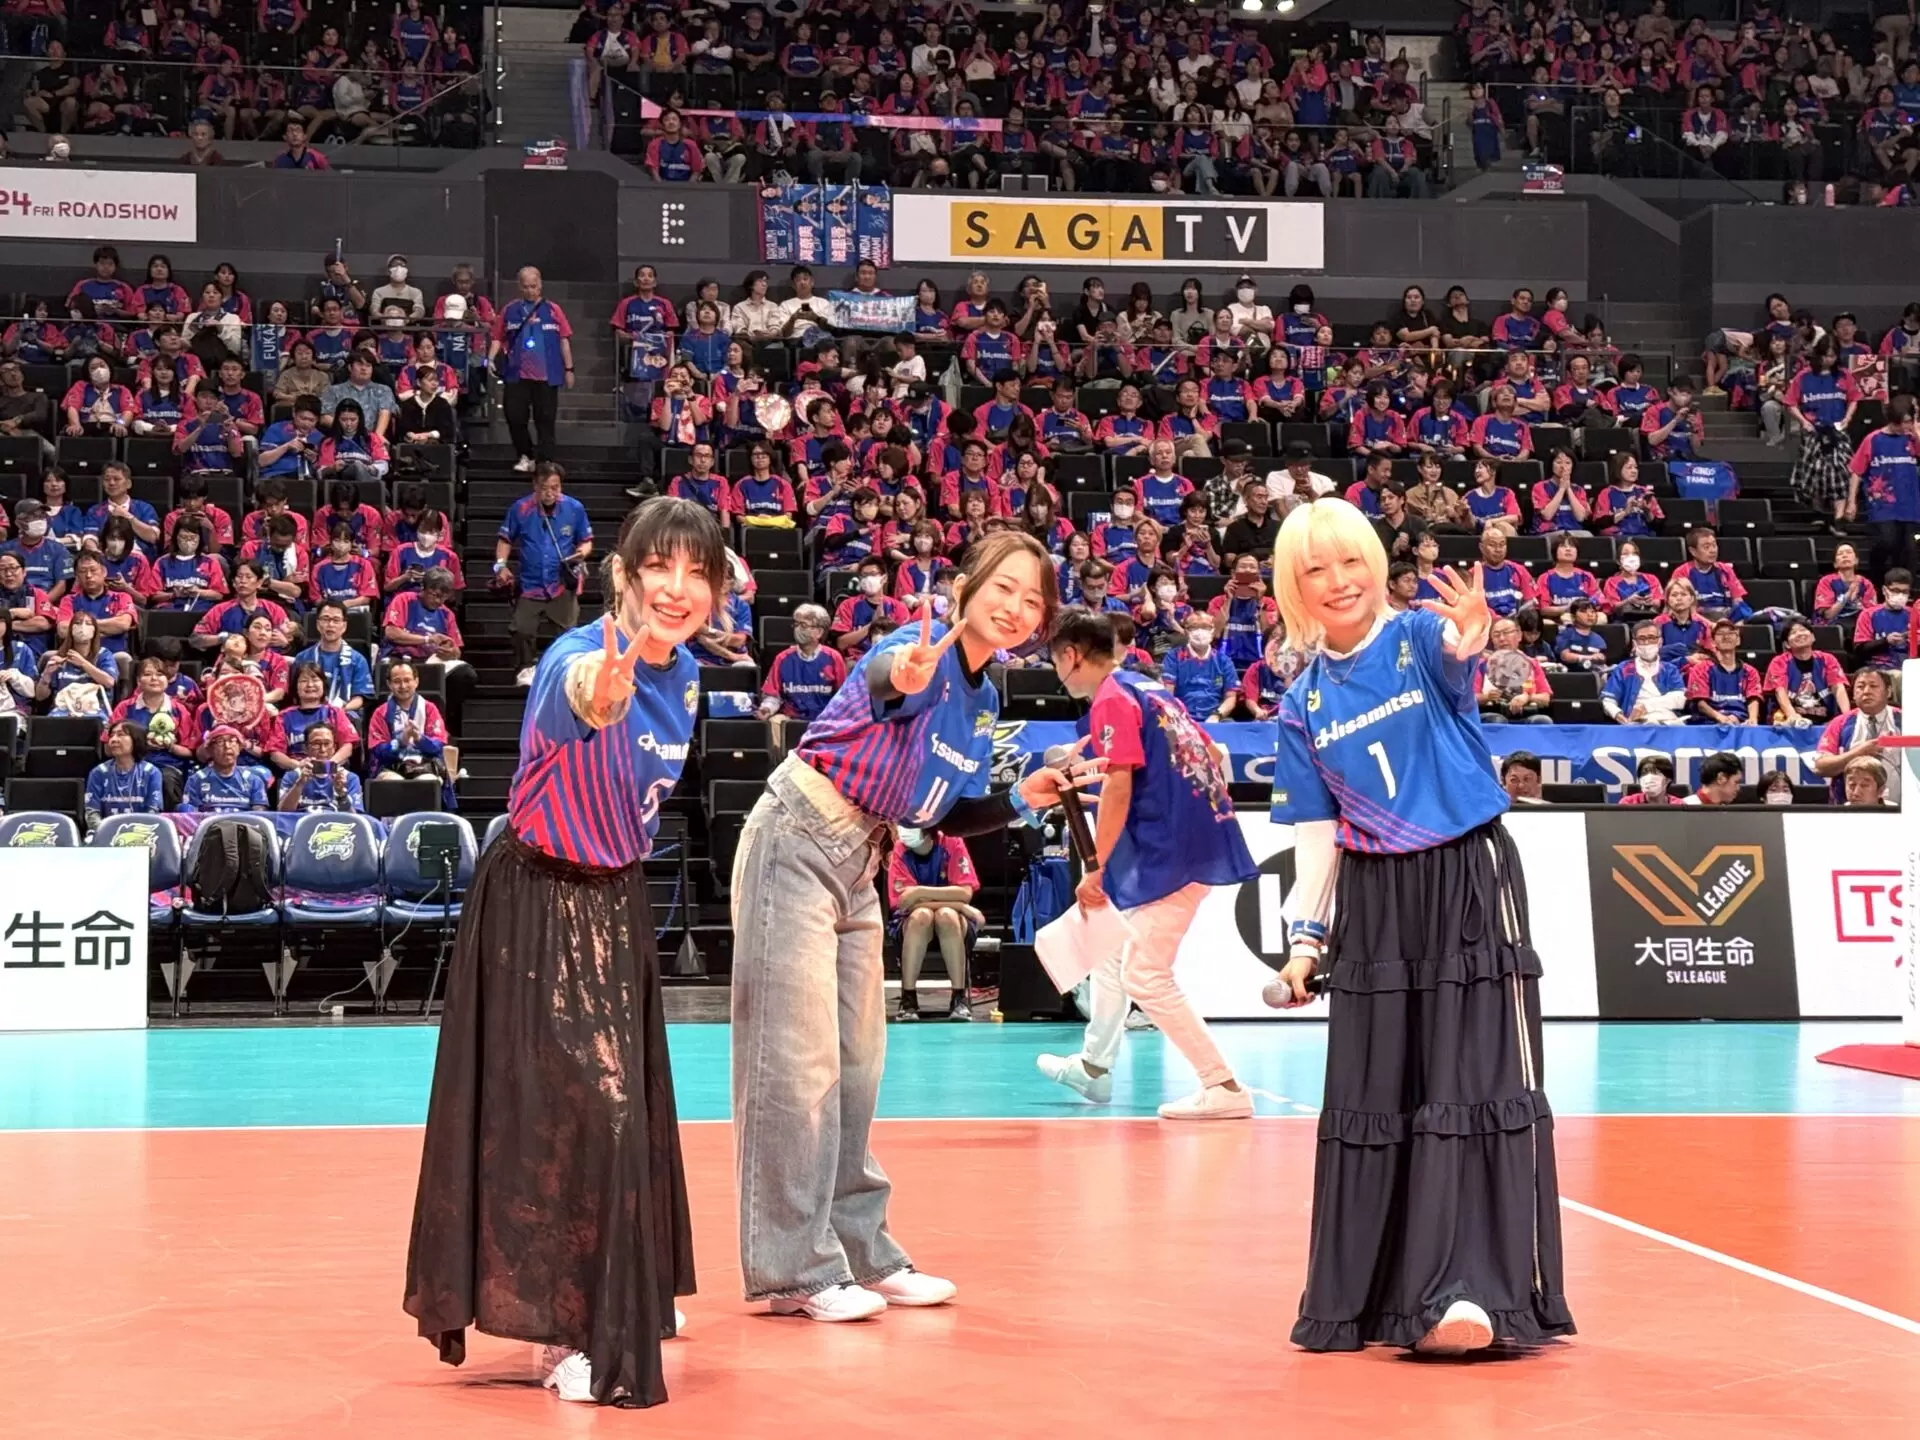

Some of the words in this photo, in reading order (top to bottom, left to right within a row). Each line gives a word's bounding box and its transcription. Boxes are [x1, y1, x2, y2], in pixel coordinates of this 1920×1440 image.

[33, 206, 54, 217] FRI
[58, 201, 178, 221] ROADSHOW
[662, 203, 685, 244] E
[966, 211, 1152, 251] SAGA
[1176, 214, 1257, 253] TV
[1315, 689, 1425, 751] Hisamitsu
[1367, 740, 1397, 800] 1
[1696, 860, 1752, 918] LEAGUE
[4, 910, 135, 970] 生命
[1634, 936, 1755, 967] 大同生命
[1666, 970, 1728, 984] SV.LEAGUE
